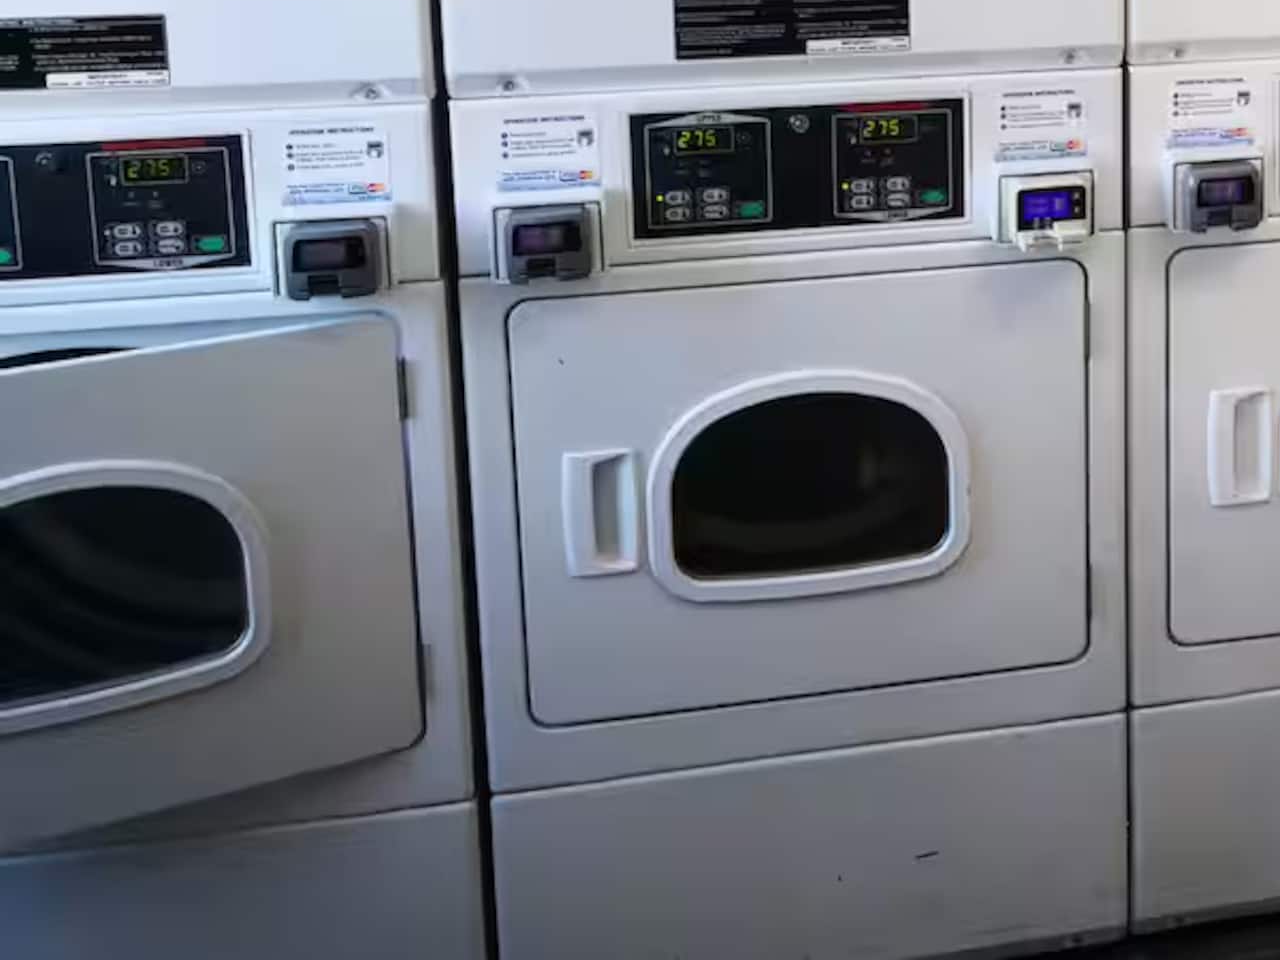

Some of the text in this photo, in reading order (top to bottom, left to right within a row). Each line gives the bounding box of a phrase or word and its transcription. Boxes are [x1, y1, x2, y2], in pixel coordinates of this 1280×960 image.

[863, 119, 900, 137] 275
[677, 129, 717, 149] 275
[126, 158, 171, 180] 275
